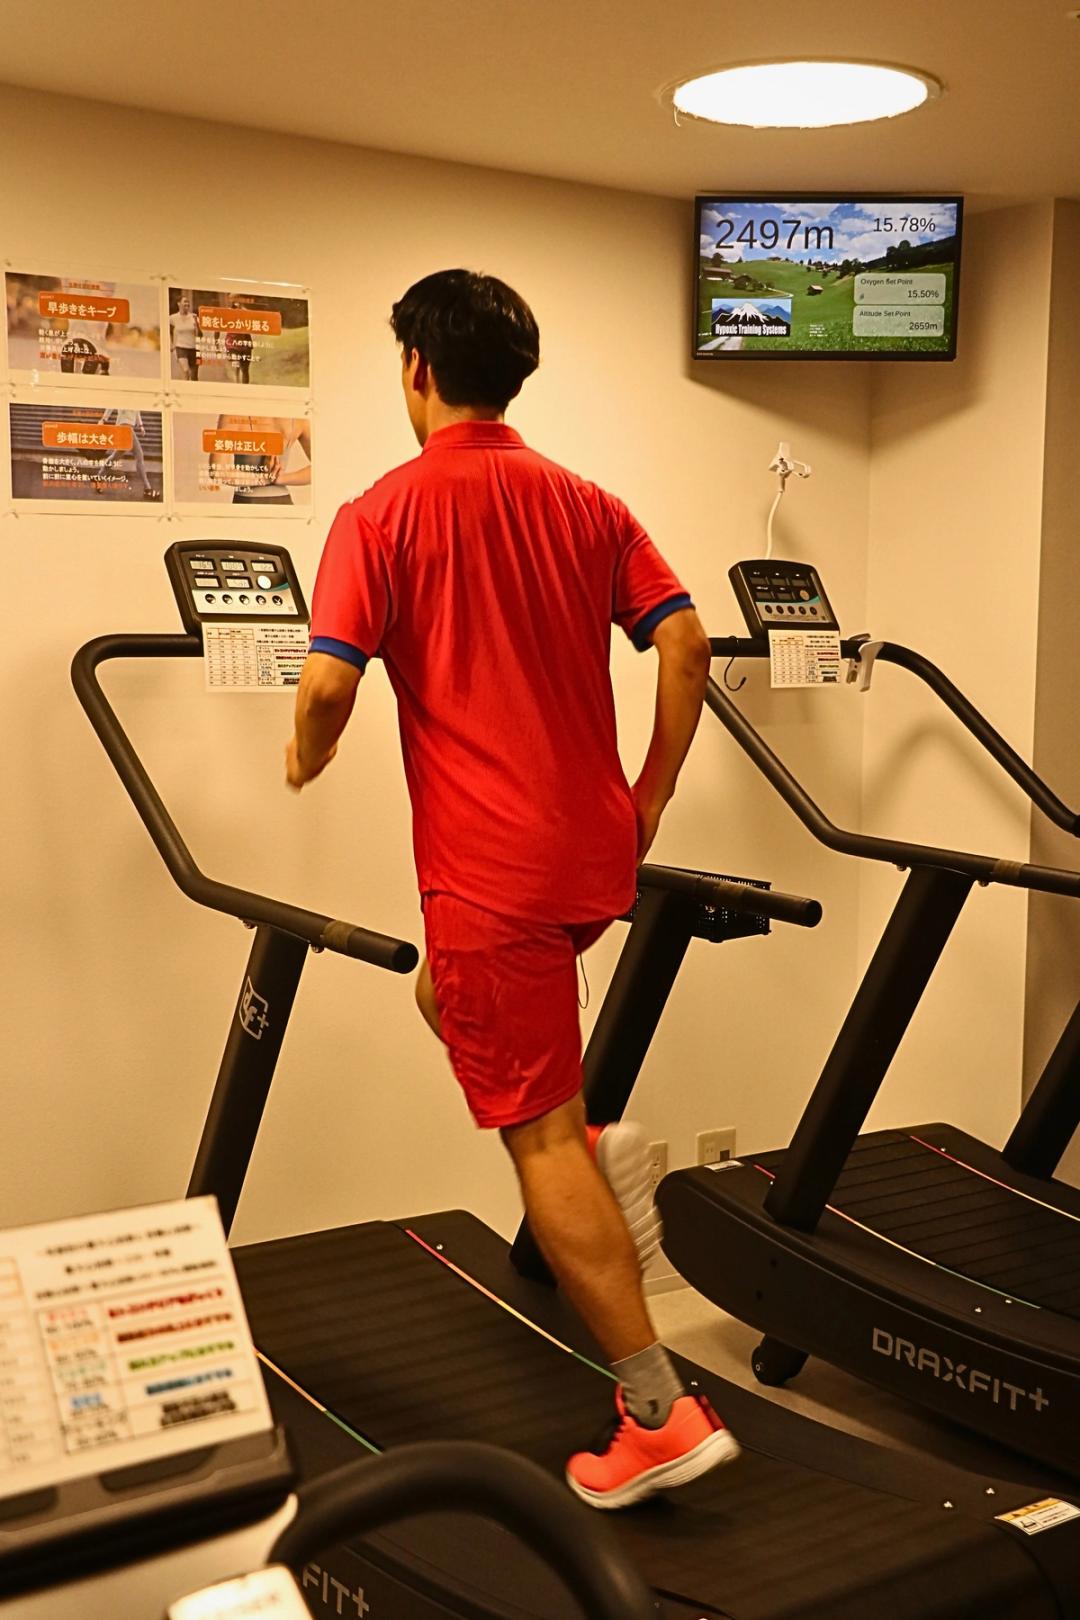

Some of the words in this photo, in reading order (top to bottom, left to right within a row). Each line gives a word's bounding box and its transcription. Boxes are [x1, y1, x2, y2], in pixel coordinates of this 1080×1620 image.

[873, 217, 936, 233] 15.78%
[715, 219, 834, 249] 2497m
[908, 290, 939, 298] 15.50%
[48, 302, 116, 317] 早歩きをキープ
[715, 324, 738, 336] Hypoxic
[738, 324, 762, 336] Training
[762, 325, 787, 335] Systems
[909, 322, 938, 330] 2659m
[56, 432, 114, 446] 歩幅は大きく
[214, 440, 266, 452] 姿勢は正しく
